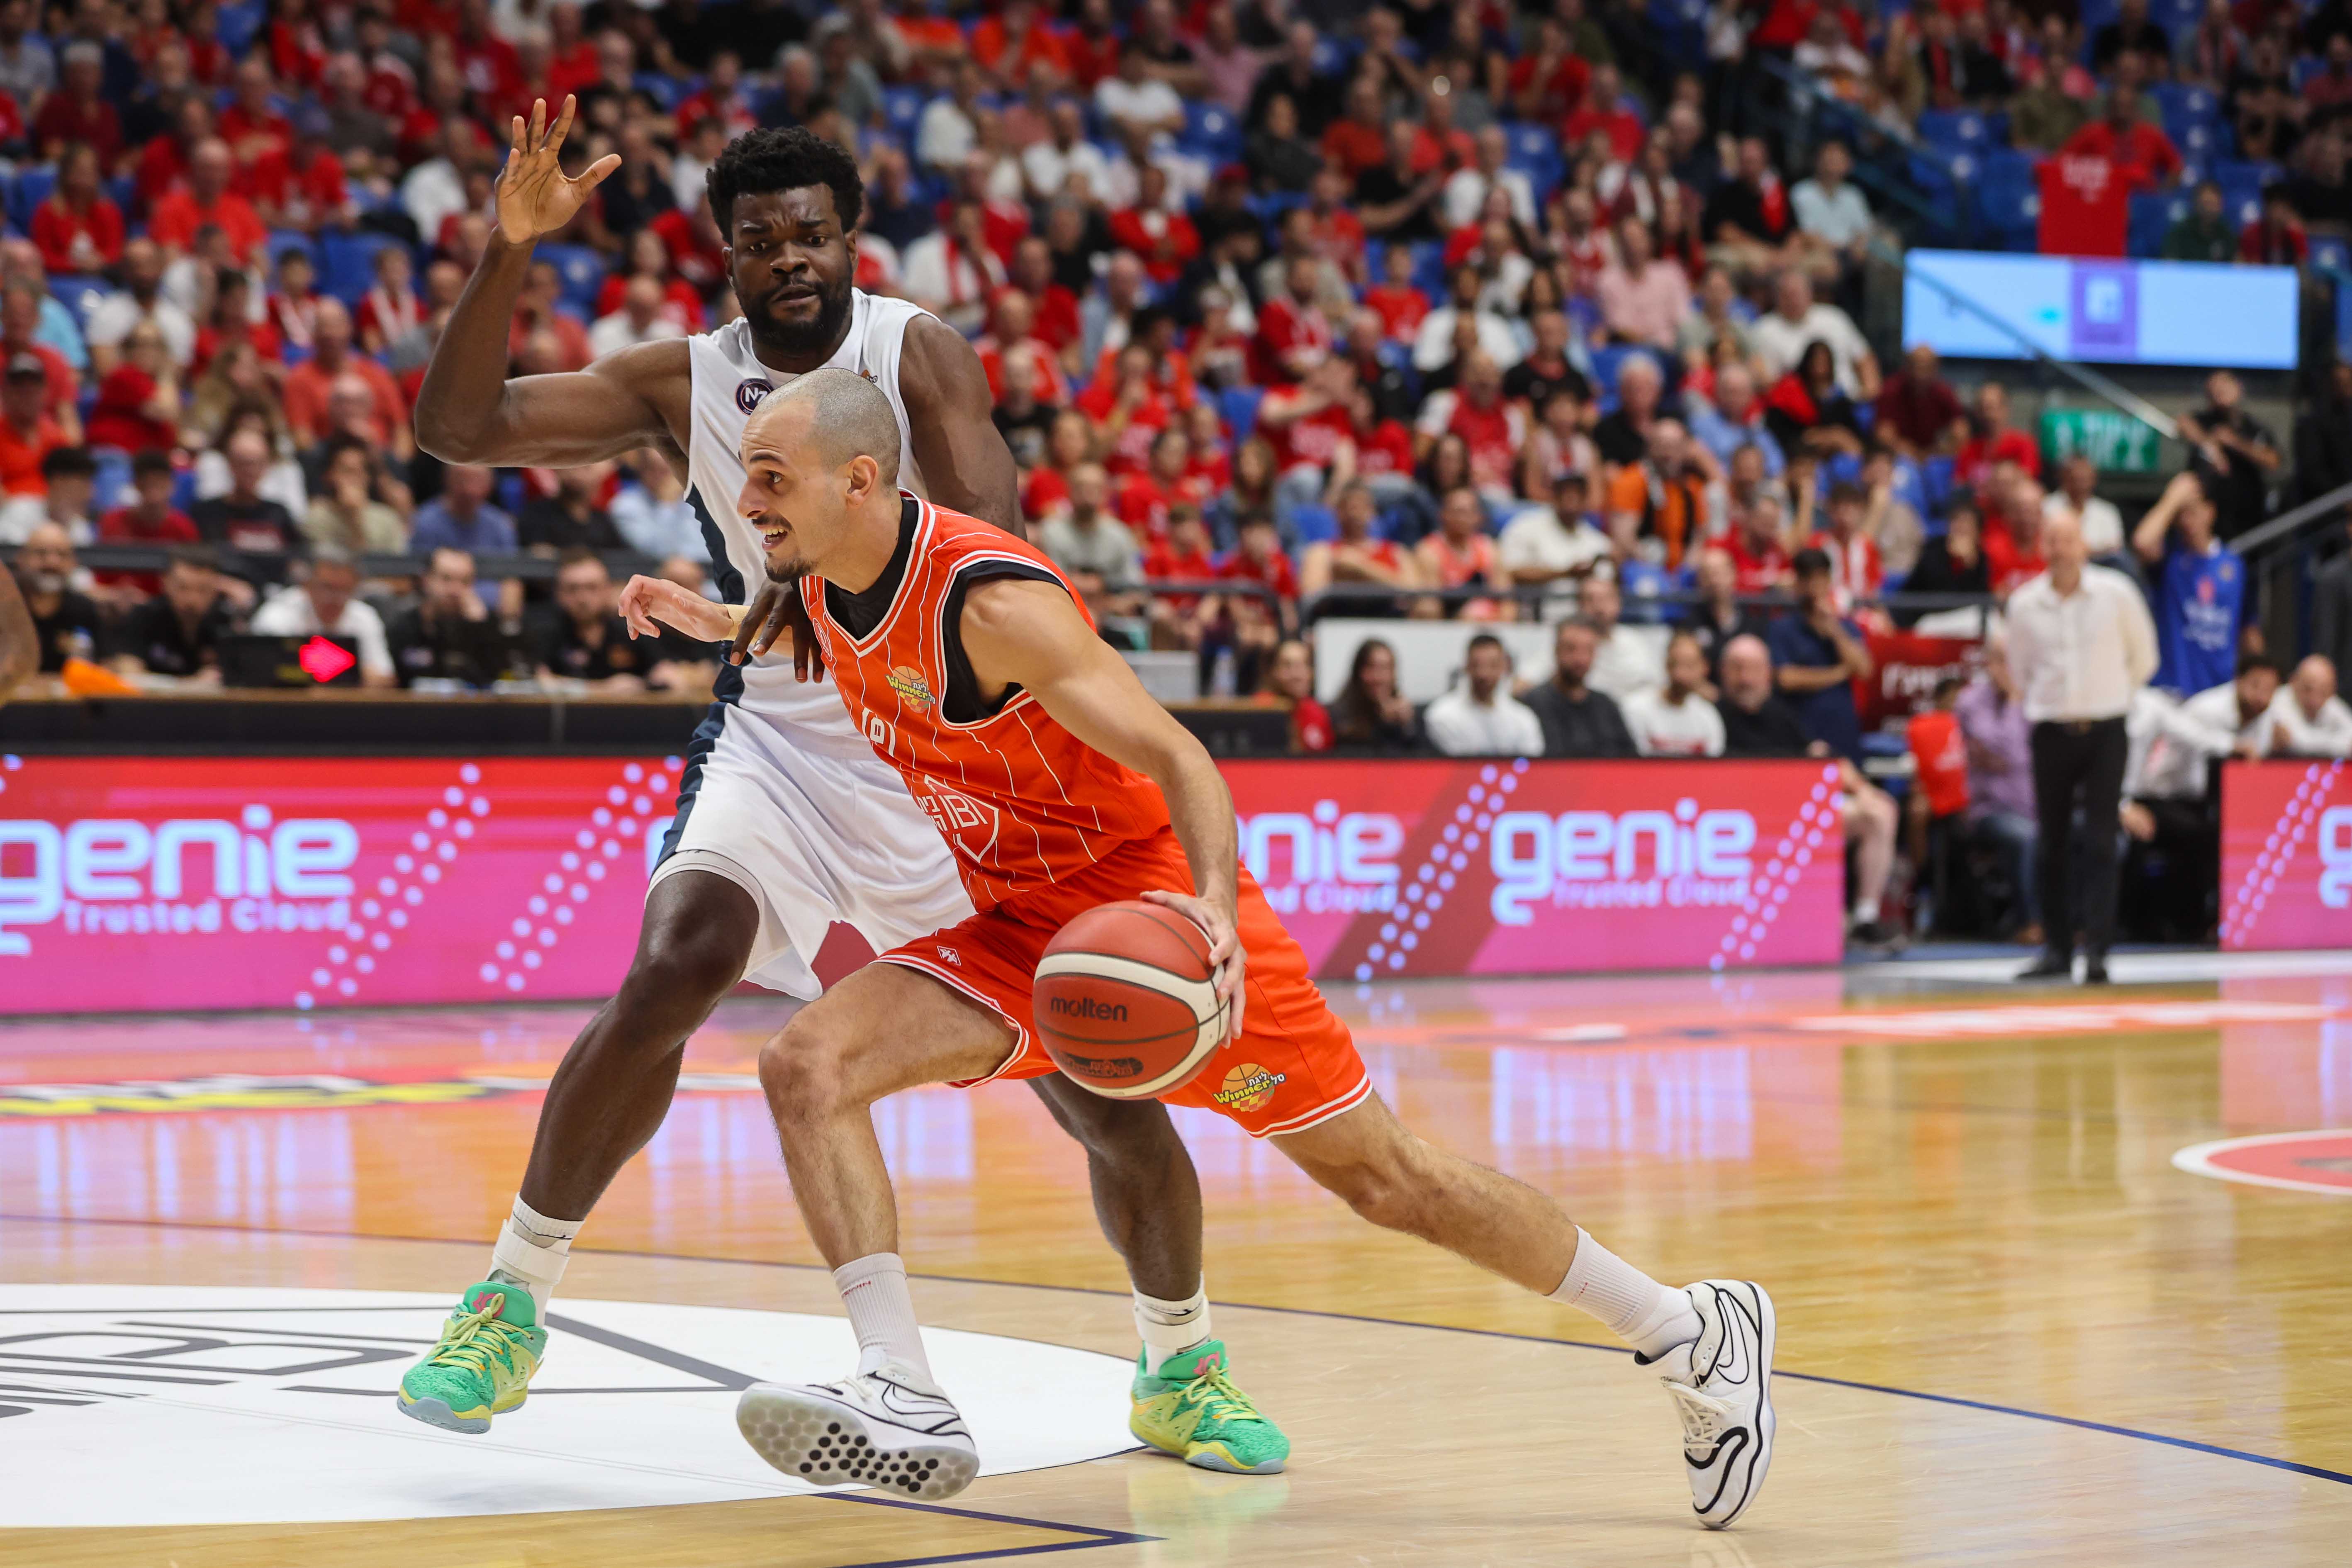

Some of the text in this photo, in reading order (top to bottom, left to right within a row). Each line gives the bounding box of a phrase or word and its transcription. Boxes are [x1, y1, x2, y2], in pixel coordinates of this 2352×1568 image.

[885, 674, 928, 699] Winner
[938, 795, 988, 830] IBI
[1236, 799, 1405, 884] nie
[1490, 796, 1757, 927] genie
[0, 803, 360, 957] genie
[63, 897, 353, 935] Trusted Cloud
[1050, 997, 1127, 1022] molten
[1213, 1079, 1271, 1104] Winner
